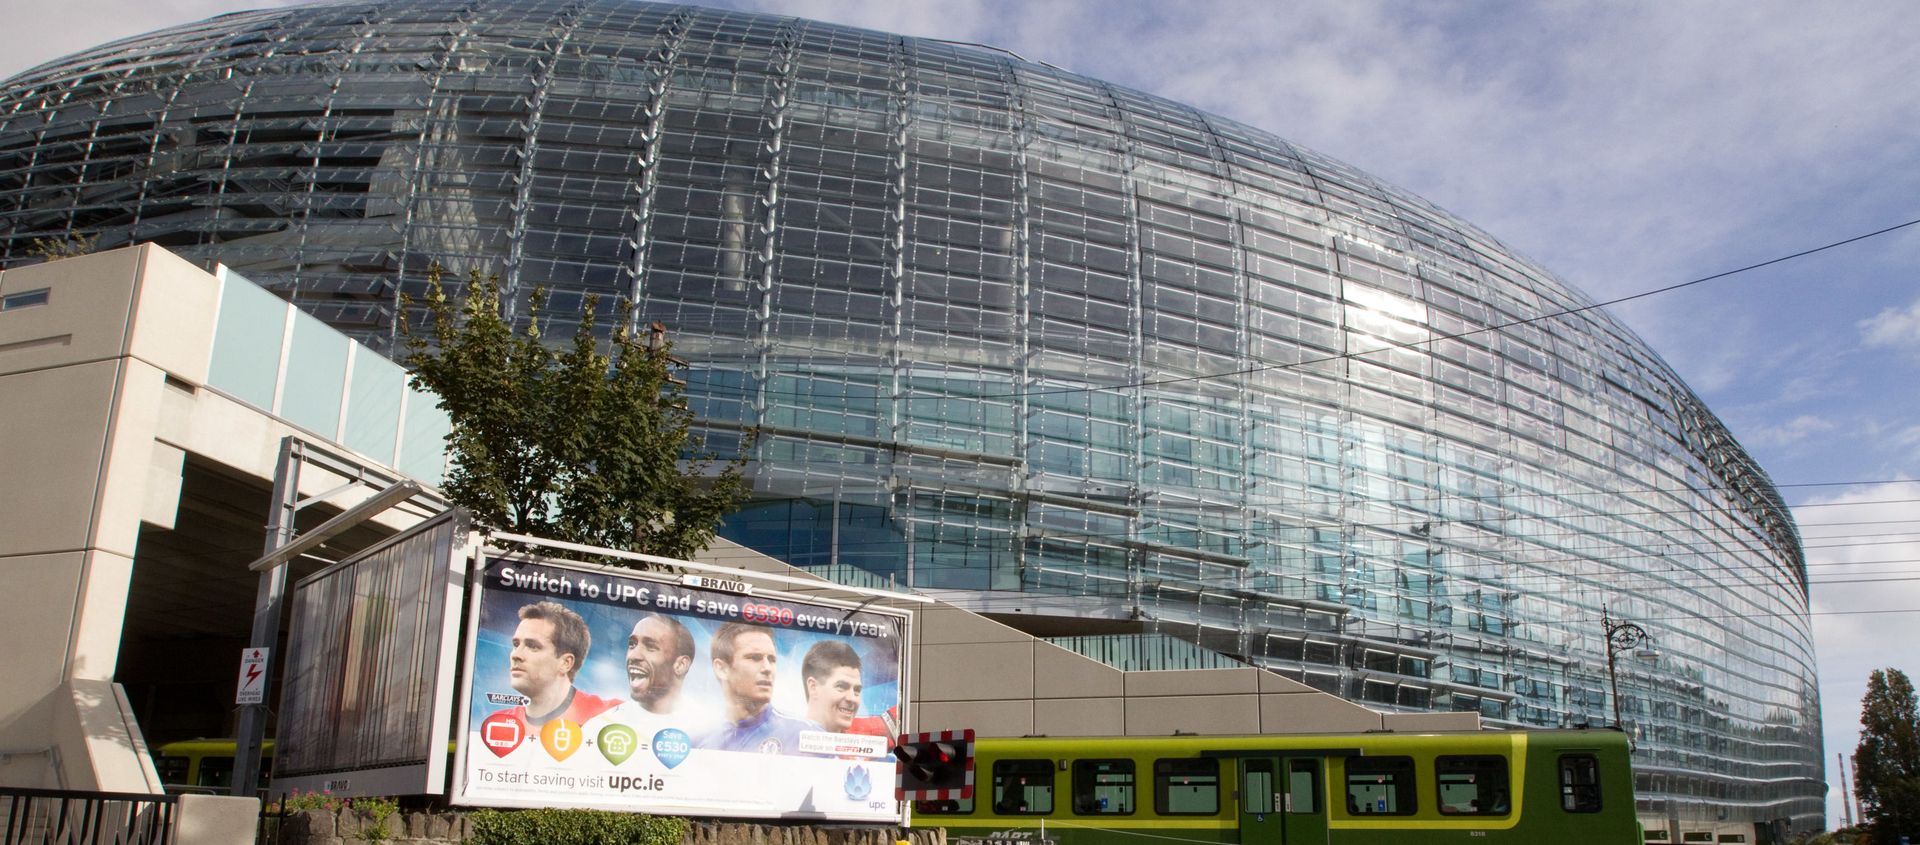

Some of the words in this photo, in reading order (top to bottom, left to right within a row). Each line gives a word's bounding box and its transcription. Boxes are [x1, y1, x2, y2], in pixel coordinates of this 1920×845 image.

[700, 577, 746, 593] BRAVO
[500, 567, 572, 595] Switch
[578, 578, 600, 599] to
[606, 582, 651, 606] UPC
[655, 594, 691, 611] and
[696, 598, 739, 617] save
[742, 602, 794, 625] €530
[796, 612, 844, 635] every
[847, 618, 888, 638] year.
[492, 694, 520, 702] BARCLAYS
[662, 730, 682, 739] Save
[834, 734, 860, 745] Barclays
[861, 737, 886, 746] Premier
[656, 740, 688, 753] €530
[478, 768, 493, 782] To
[497, 770, 529, 784] start
[533, 772, 575, 790] saving
[579, 774, 604, 788] visit
[608, 774, 665, 793] upc.ie
[869, 801, 886, 812] upc
